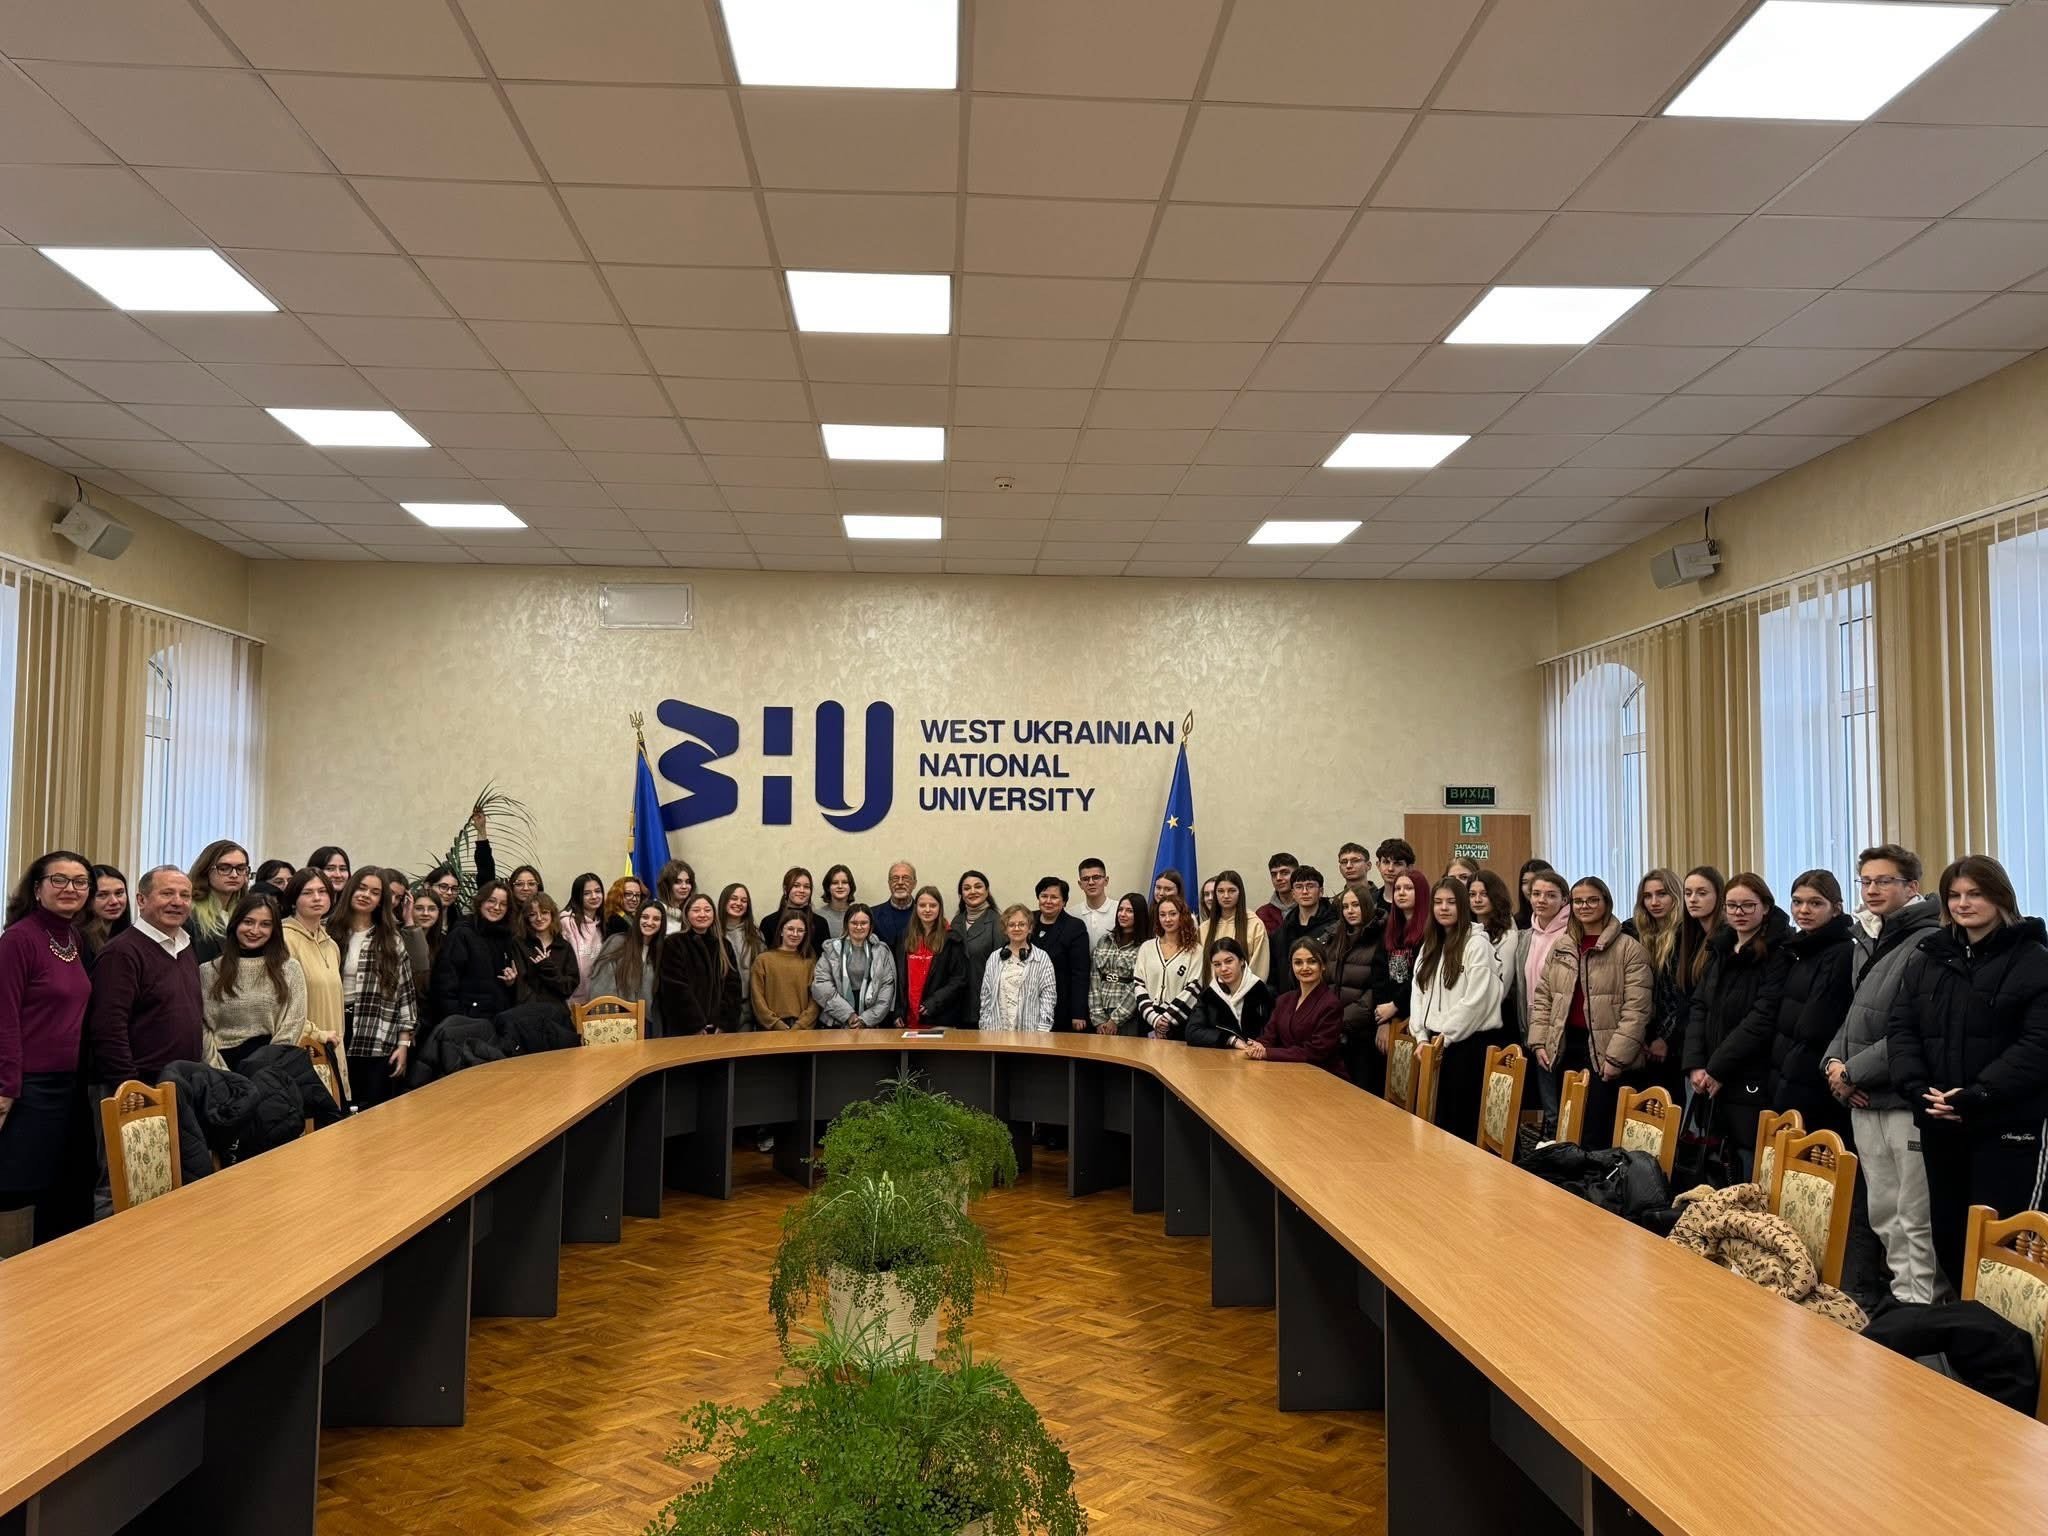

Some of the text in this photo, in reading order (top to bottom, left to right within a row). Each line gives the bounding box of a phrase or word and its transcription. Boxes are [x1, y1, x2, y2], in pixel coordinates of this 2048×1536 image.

[920, 719, 1174, 745] WEST UKRAINIAN
[919, 753, 1070, 778] NATIONAL
[919, 786, 1096, 812] UNIVERSITY
[1450, 788, 1489, 800] ВИХІД
[1455, 850, 1488, 858] ВИХІД
